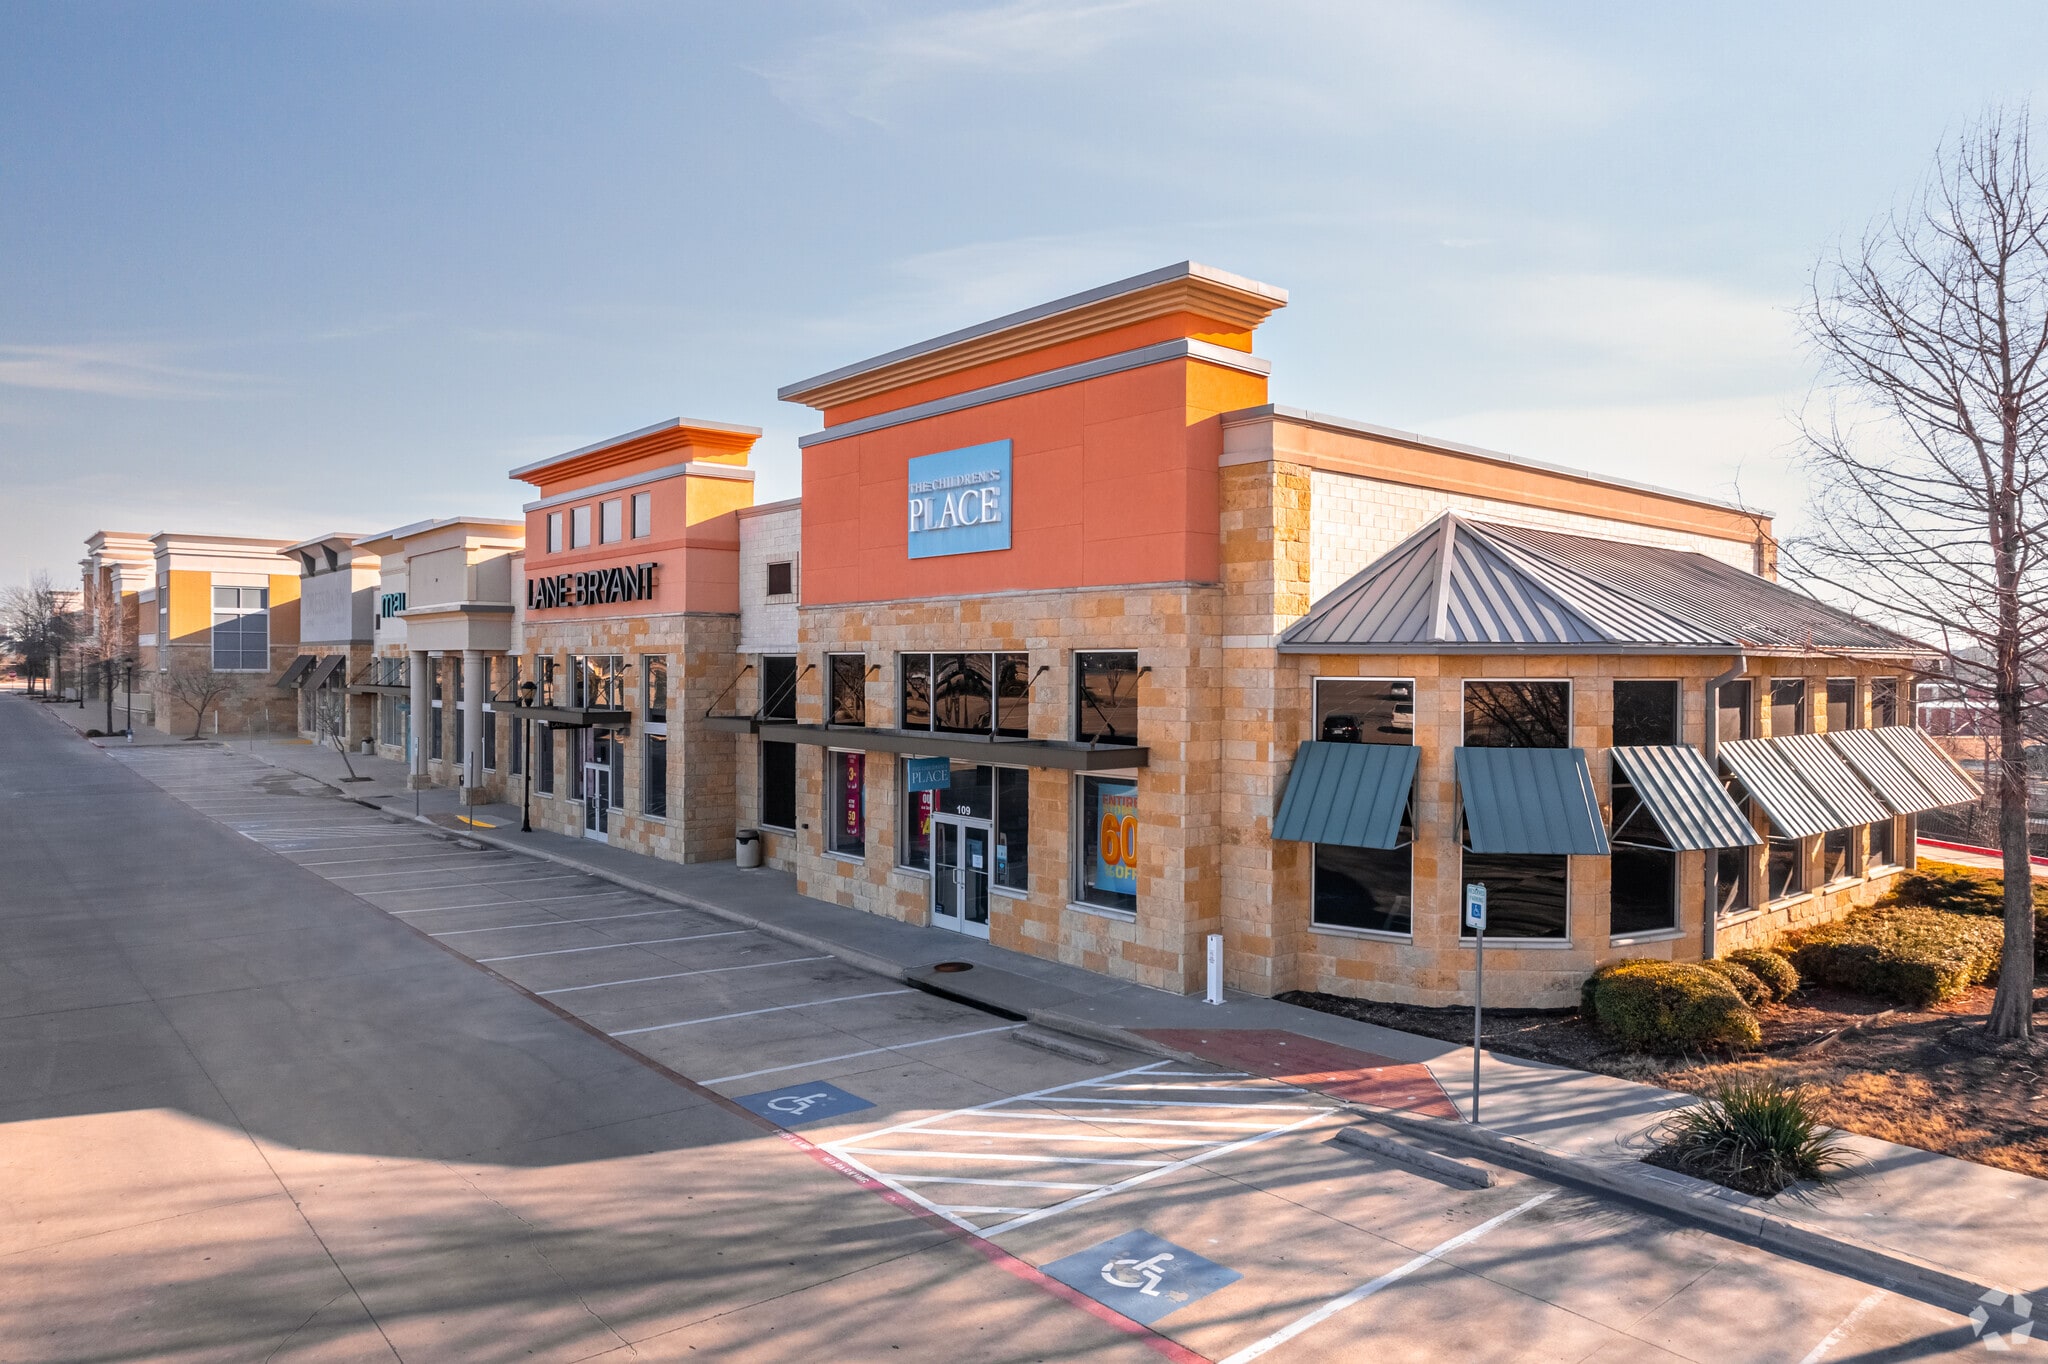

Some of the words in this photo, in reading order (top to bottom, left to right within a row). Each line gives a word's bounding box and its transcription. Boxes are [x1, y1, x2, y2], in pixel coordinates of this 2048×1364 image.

[909, 481, 932, 494] THE
[909, 487, 1001, 533] PLACE
[527, 574, 573, 610] LANE
[575, 562, 658, 607] BRYANT
[912, 769, 948, 784] PLACE
[957, 805, 971, 816] 109
[1101, 812, 1137, 868] 60
[822, 1156, 836, 1166] NO
[833, 1162, 869, 1184] PARKING
